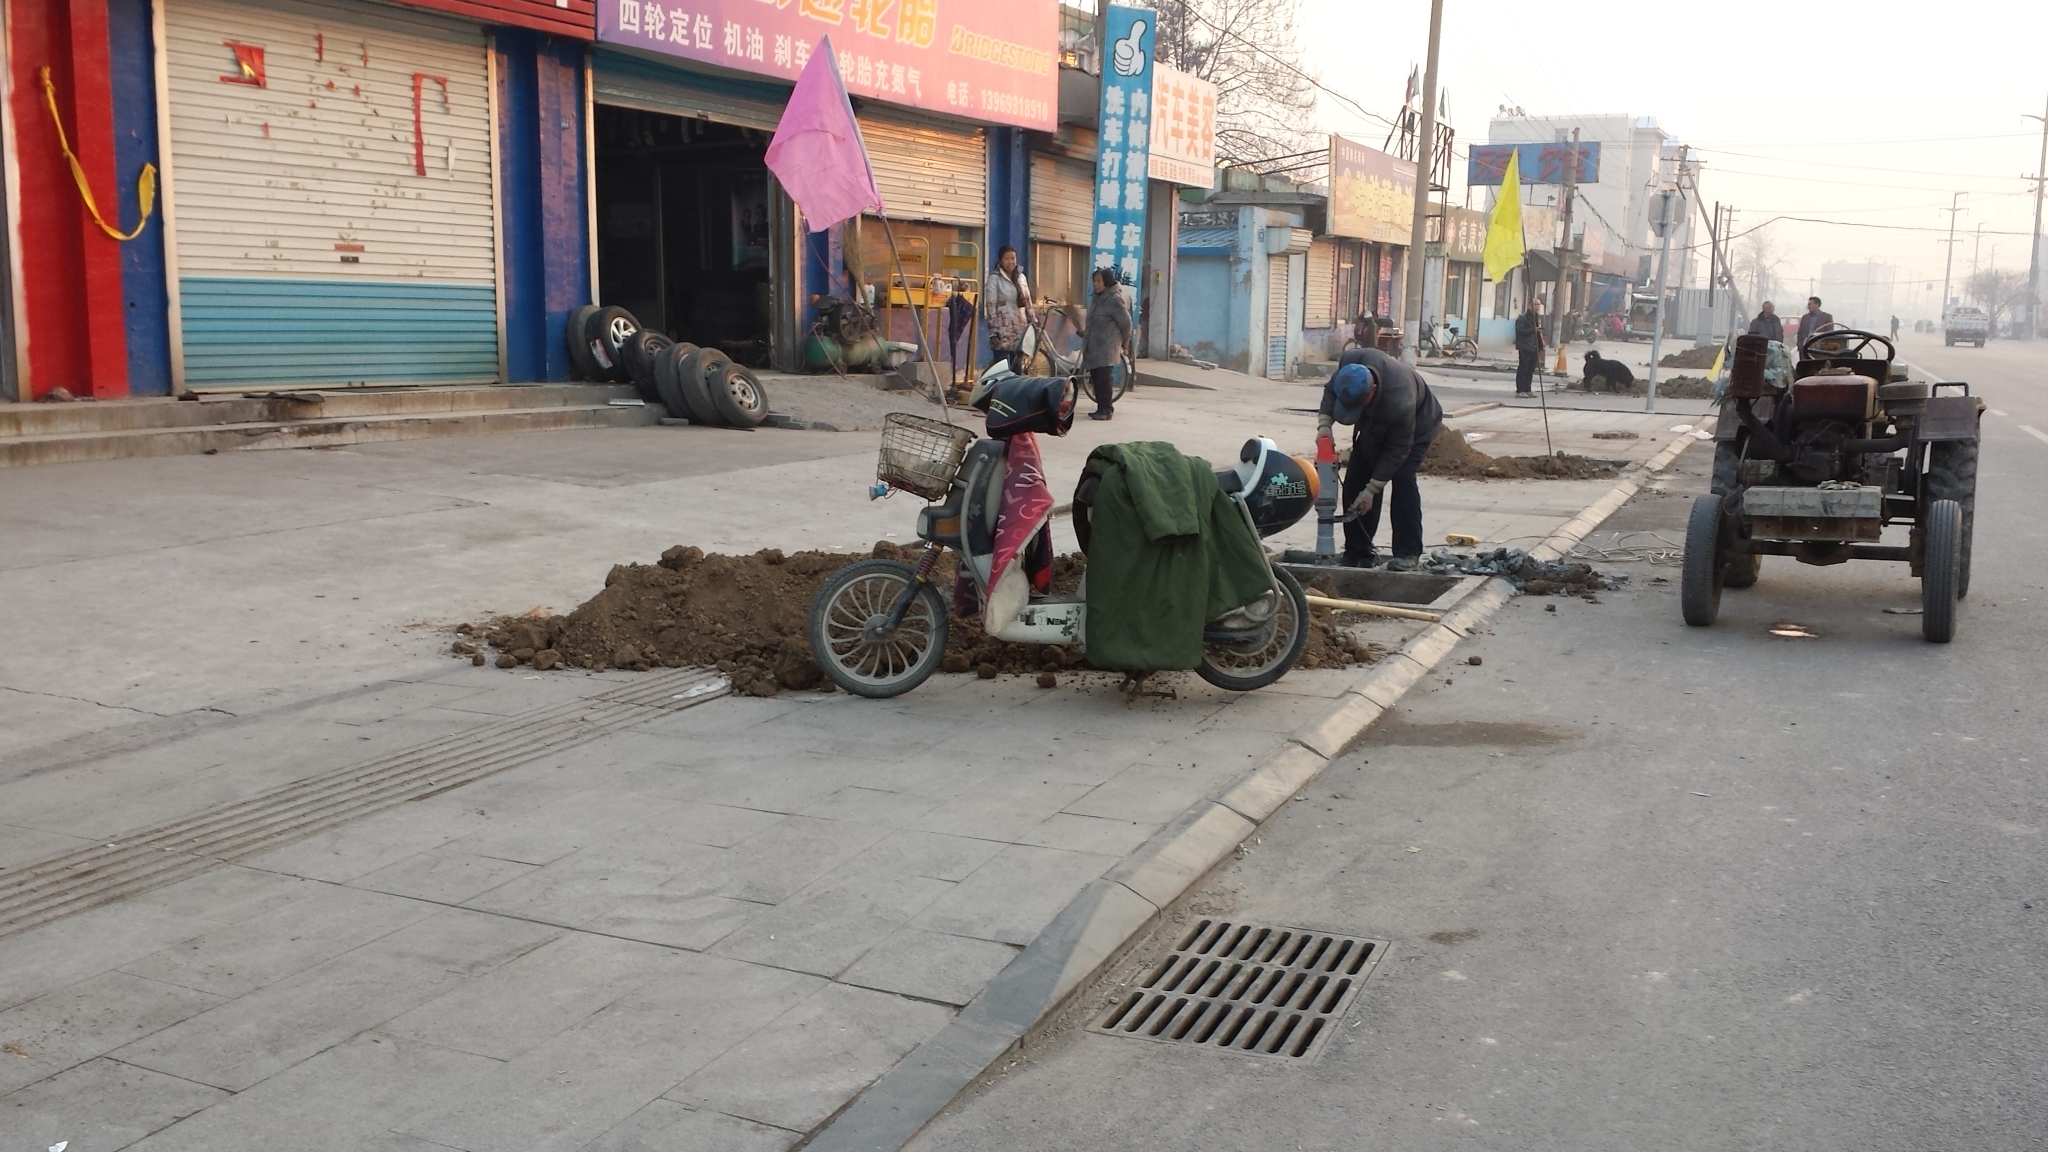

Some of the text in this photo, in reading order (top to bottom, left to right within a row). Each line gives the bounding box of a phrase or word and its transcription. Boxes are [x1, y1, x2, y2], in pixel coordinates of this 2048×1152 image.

[619, 0, 713, 50] 四轮定位
[724, 21, 764, 62] 机油
[839, 49, 922, 98] 轮胎充氮气
[949, 25, 1052, 76] BRIDGESTONE
[1155, 74, 1214, 161] 汽车美容
